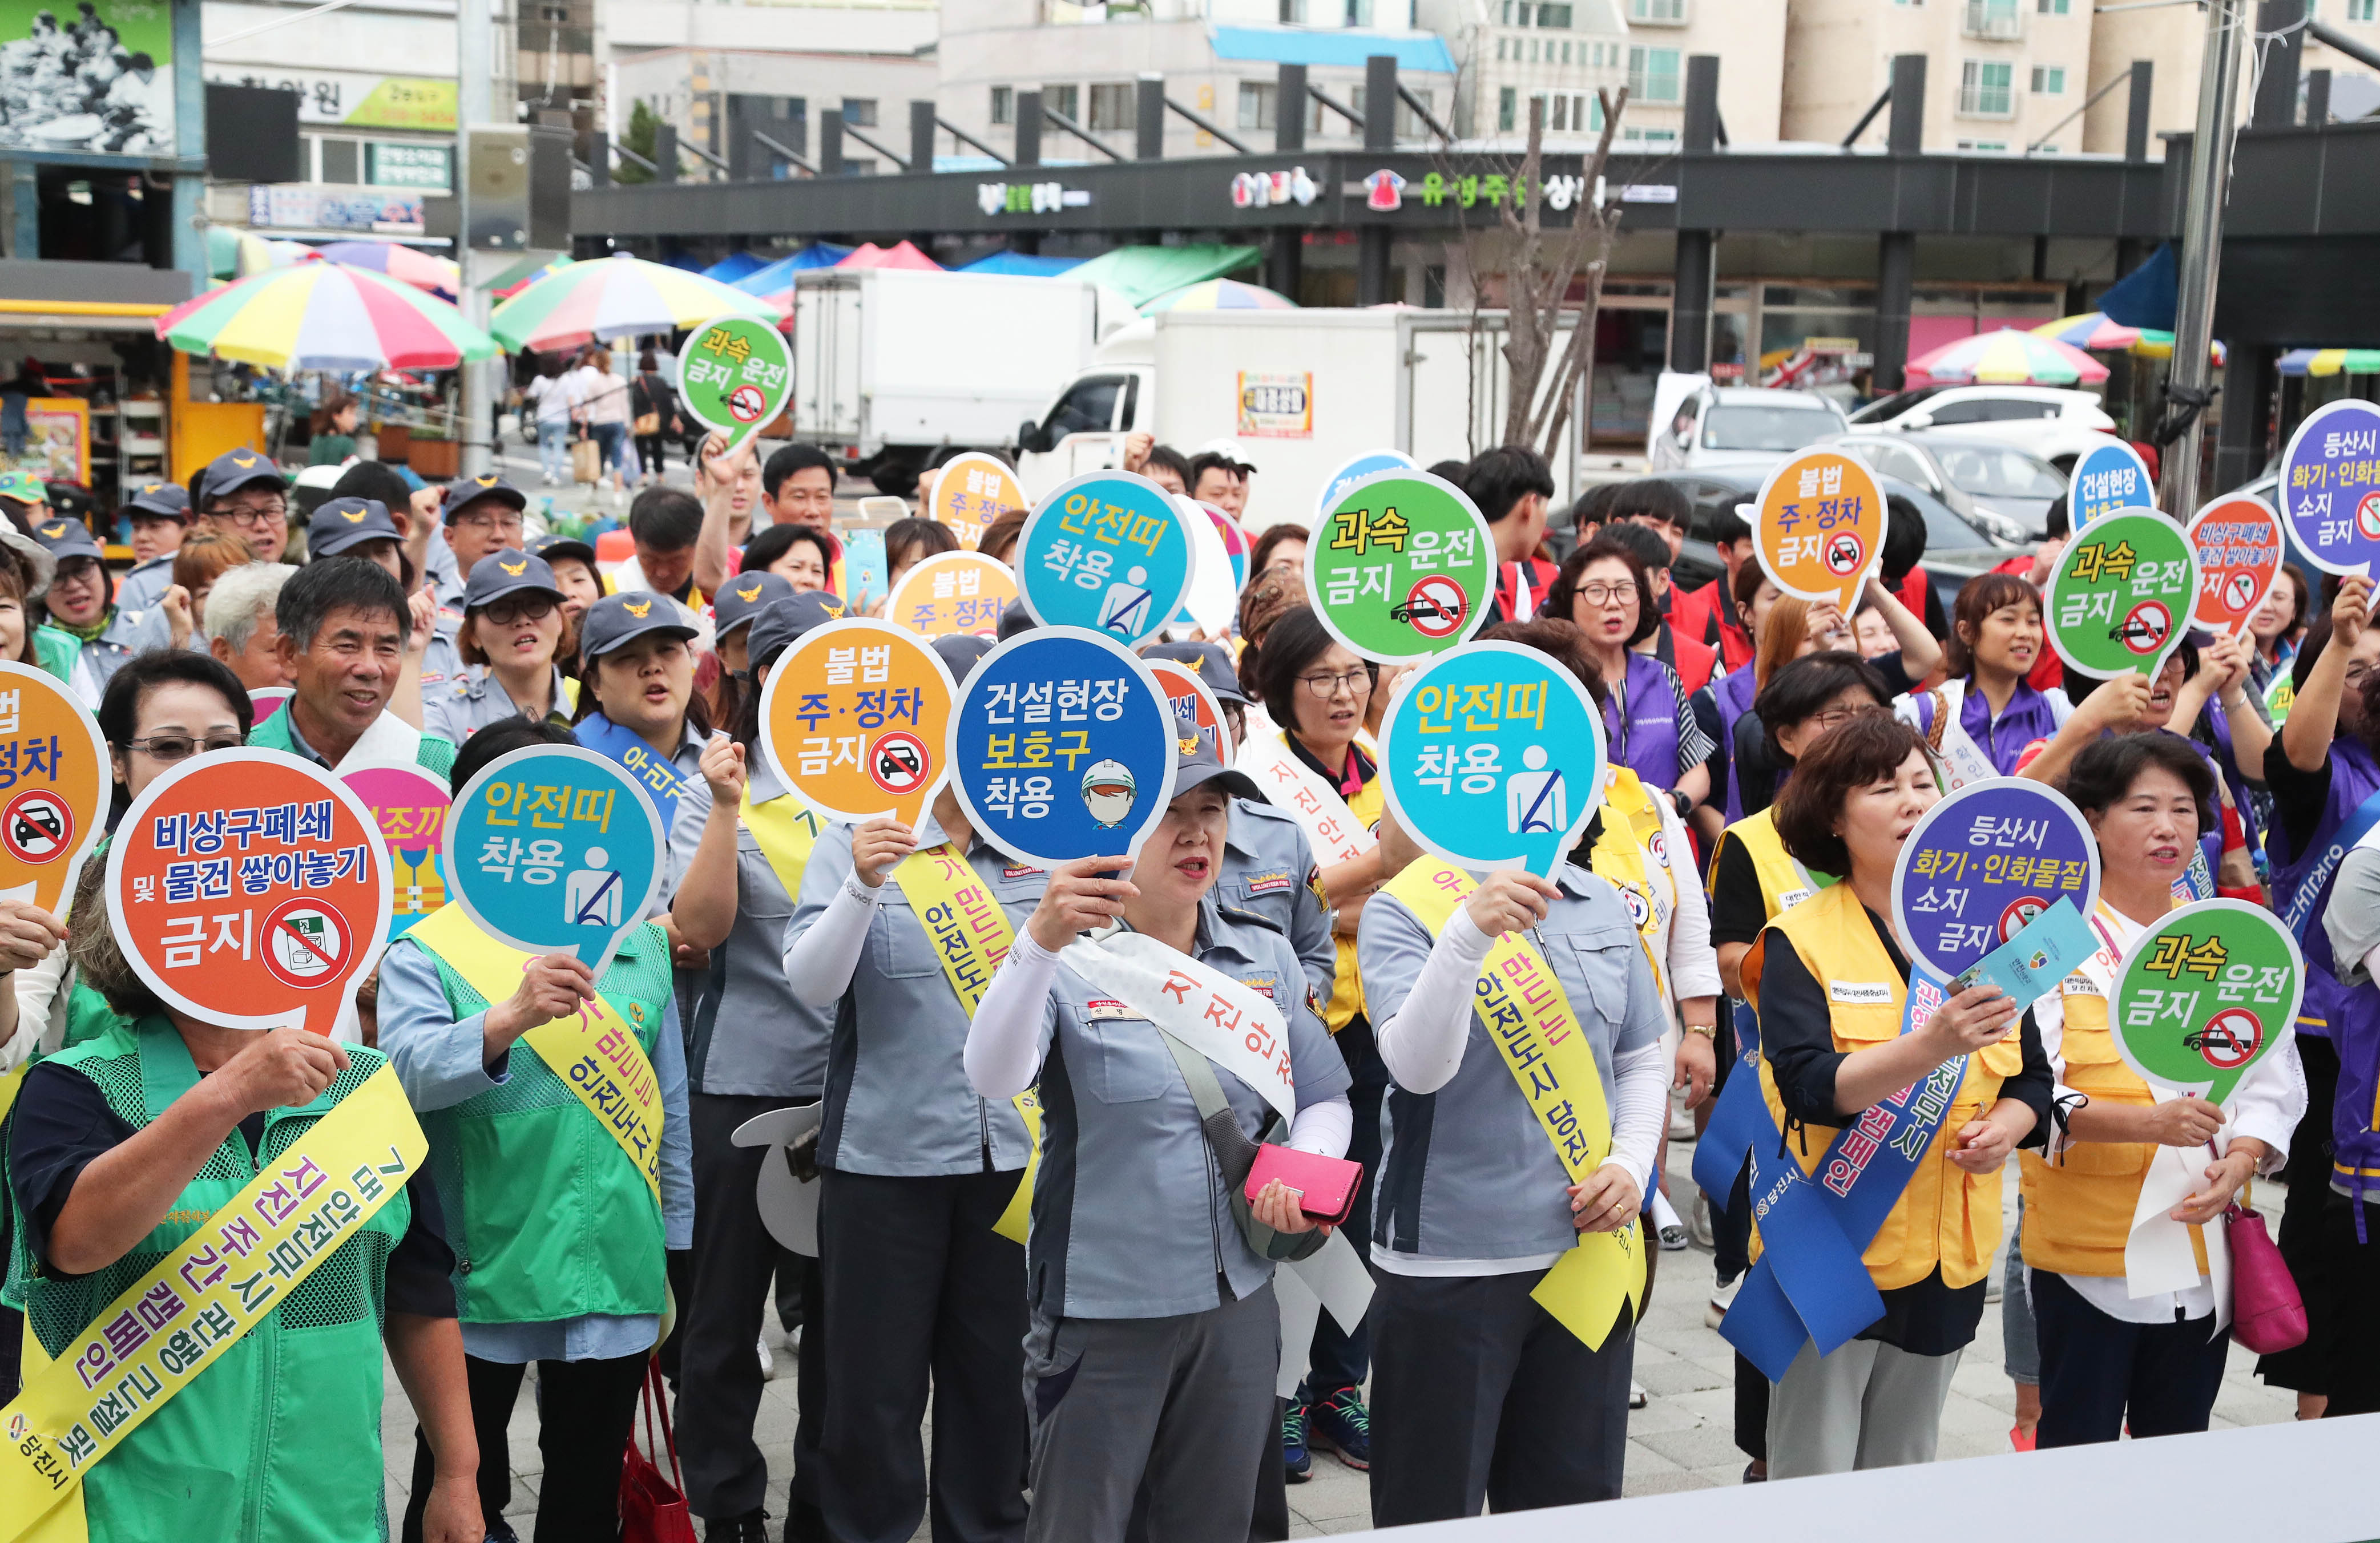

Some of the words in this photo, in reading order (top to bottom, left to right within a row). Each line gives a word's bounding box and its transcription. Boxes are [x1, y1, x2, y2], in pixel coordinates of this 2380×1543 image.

[687, 357, 733, 391] 금지
[701, 326, 751, 365] 과속
[741, 357, 786, 390] 운전
[2323, 429, 2377, 459] 등산시
[966, 468, 1002, 498] 불법
[1798, 464, 1844, 498] 불법
[2083, 466, 2137, 502] 건설현장
[2296, 491, 2333, 518] 소지
[1063, 493, 1169, 558] 안전띠
[1329, 507, 1410, 556] 과속
[1407, 527, 1476, 571] 운전
[2199, 522, 2272, 545] 비상구폐쇄
[2318, 518, 2353, 547] 금지
[1043, 538, 1115, 591] 착용
[1777, 531, 1824, 568] 금지
[2070, 540, 2136, 584] 과속
[2131, 558, 2189, 597] 운전
[2200, 546, 2225, 567] 물건
[2225, 546, 2277, 567] 쌓아놓기
[932, 568, 981, 599] 불법
[1325, 563, 1393, 606] 금지
[2201, 572, 2225, 598] 지
[2059, 589, 2117, 628] 금지
[824, 645, 891, 685] 불법
[983, 677, 1130, 724] 건설현장
[1415, 680, 1548, 734] 안전띠
[797, 733, 866, 776] 금지
[982, 731, 1091, 771] 보호구
[1414, 744, 1503, 795] 착용
[485, 782, 616, 834] 안전띠
[983, 775, 1055, 820] 착용
[154, 800, 334, 856] 비상구폐쇄
[1968, 815, 2050, 851] 등산시
[132, 876, 156, 903] 및
[163, 857, 231, 903] 물건
[239, 844, 368, 895] 쌓아놓기
[478, 836, 564, 884] 착용
[1005, 867, 1032, 876] VOLUNTEER
[1913, 849, 2088, 890] 화기·인화물질
[1252, 881, 1279, 891] VOLUNTEER
[1912, 887, 1969, 918] 소지
[160, 908, 252, 968] 금지
[1938, 923, 1994, 955] 금지
[2145, 934, 2228, 981] 과속
[2217, 964, 2290, 1003] 운전
[1501, 952, 1571, 1047] 만드는
[2127, 989, 2200, 1028] 금지
[596, 1028, 655, 1108] 만드는
[1477, 972, 1559, 1101] 안전도시
[1546, 1100, 1589, 1166] 당진
[570, 1055, 651, 1161] 안전도시
[1824, 1104, 1897, 1198] 캠페인
[252, 1154, 330, 1228] 지진
[350, 1146, 406, 1204] 7대
[1768, 1167, 1798, 1206] 당진시
[178, 1214, 264, 1296] 주간
[231, 1190, 362, 1313] 안전무시
[75, 1280, 187, 1392] 캠페인
[159, 1301, 236, 1375] 관행
[89, 1364, 162, 1438] 근절
[19, 1434, 68, 1493] 당진시
[59, 1422, 96, 1469] 및
